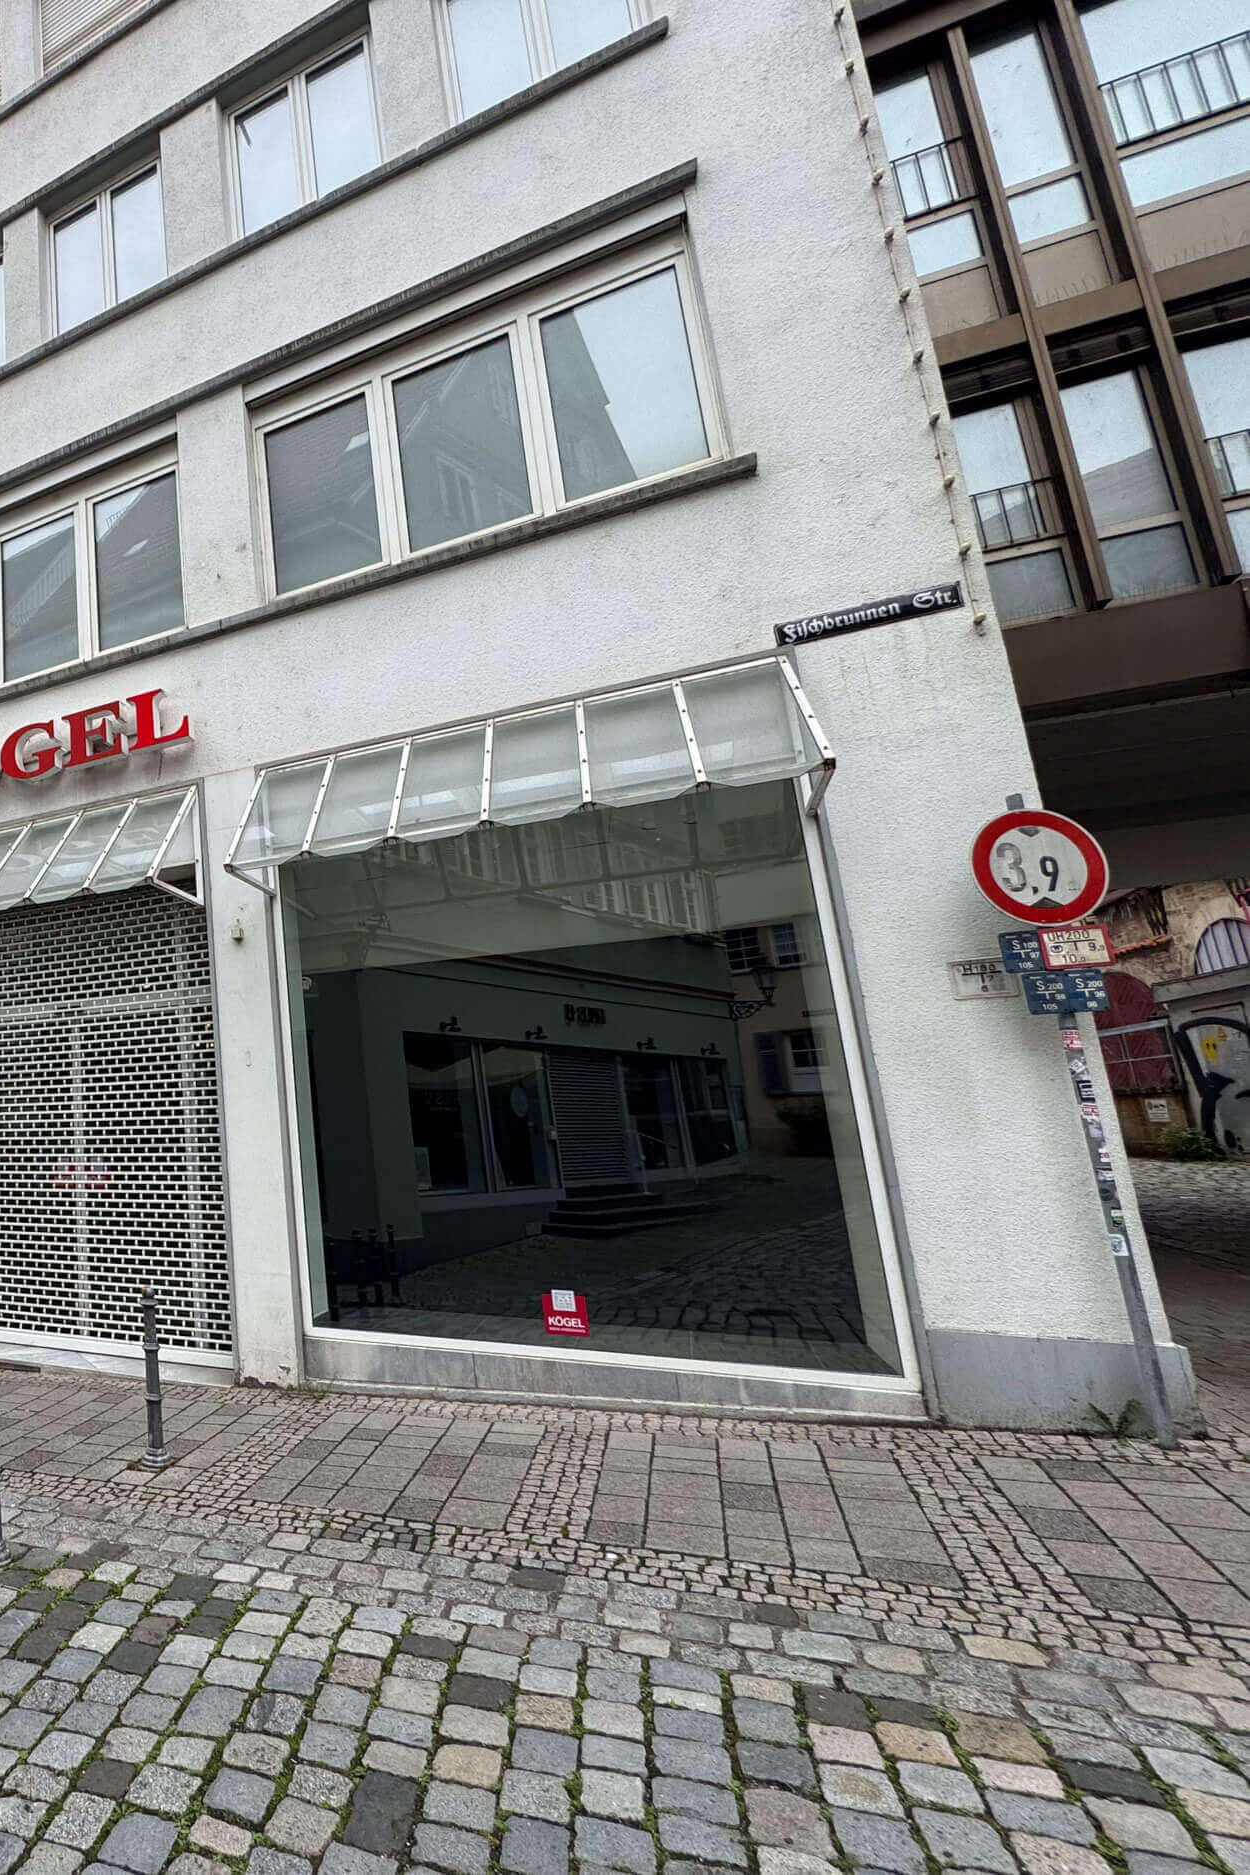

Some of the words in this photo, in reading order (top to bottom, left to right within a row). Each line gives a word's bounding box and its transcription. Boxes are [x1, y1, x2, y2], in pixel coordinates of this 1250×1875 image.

[912, 590, 958, 609] Str.
[996, 842, 1059, 894] 3,9
[548, 1315, 586, 1328] KÖGEL
